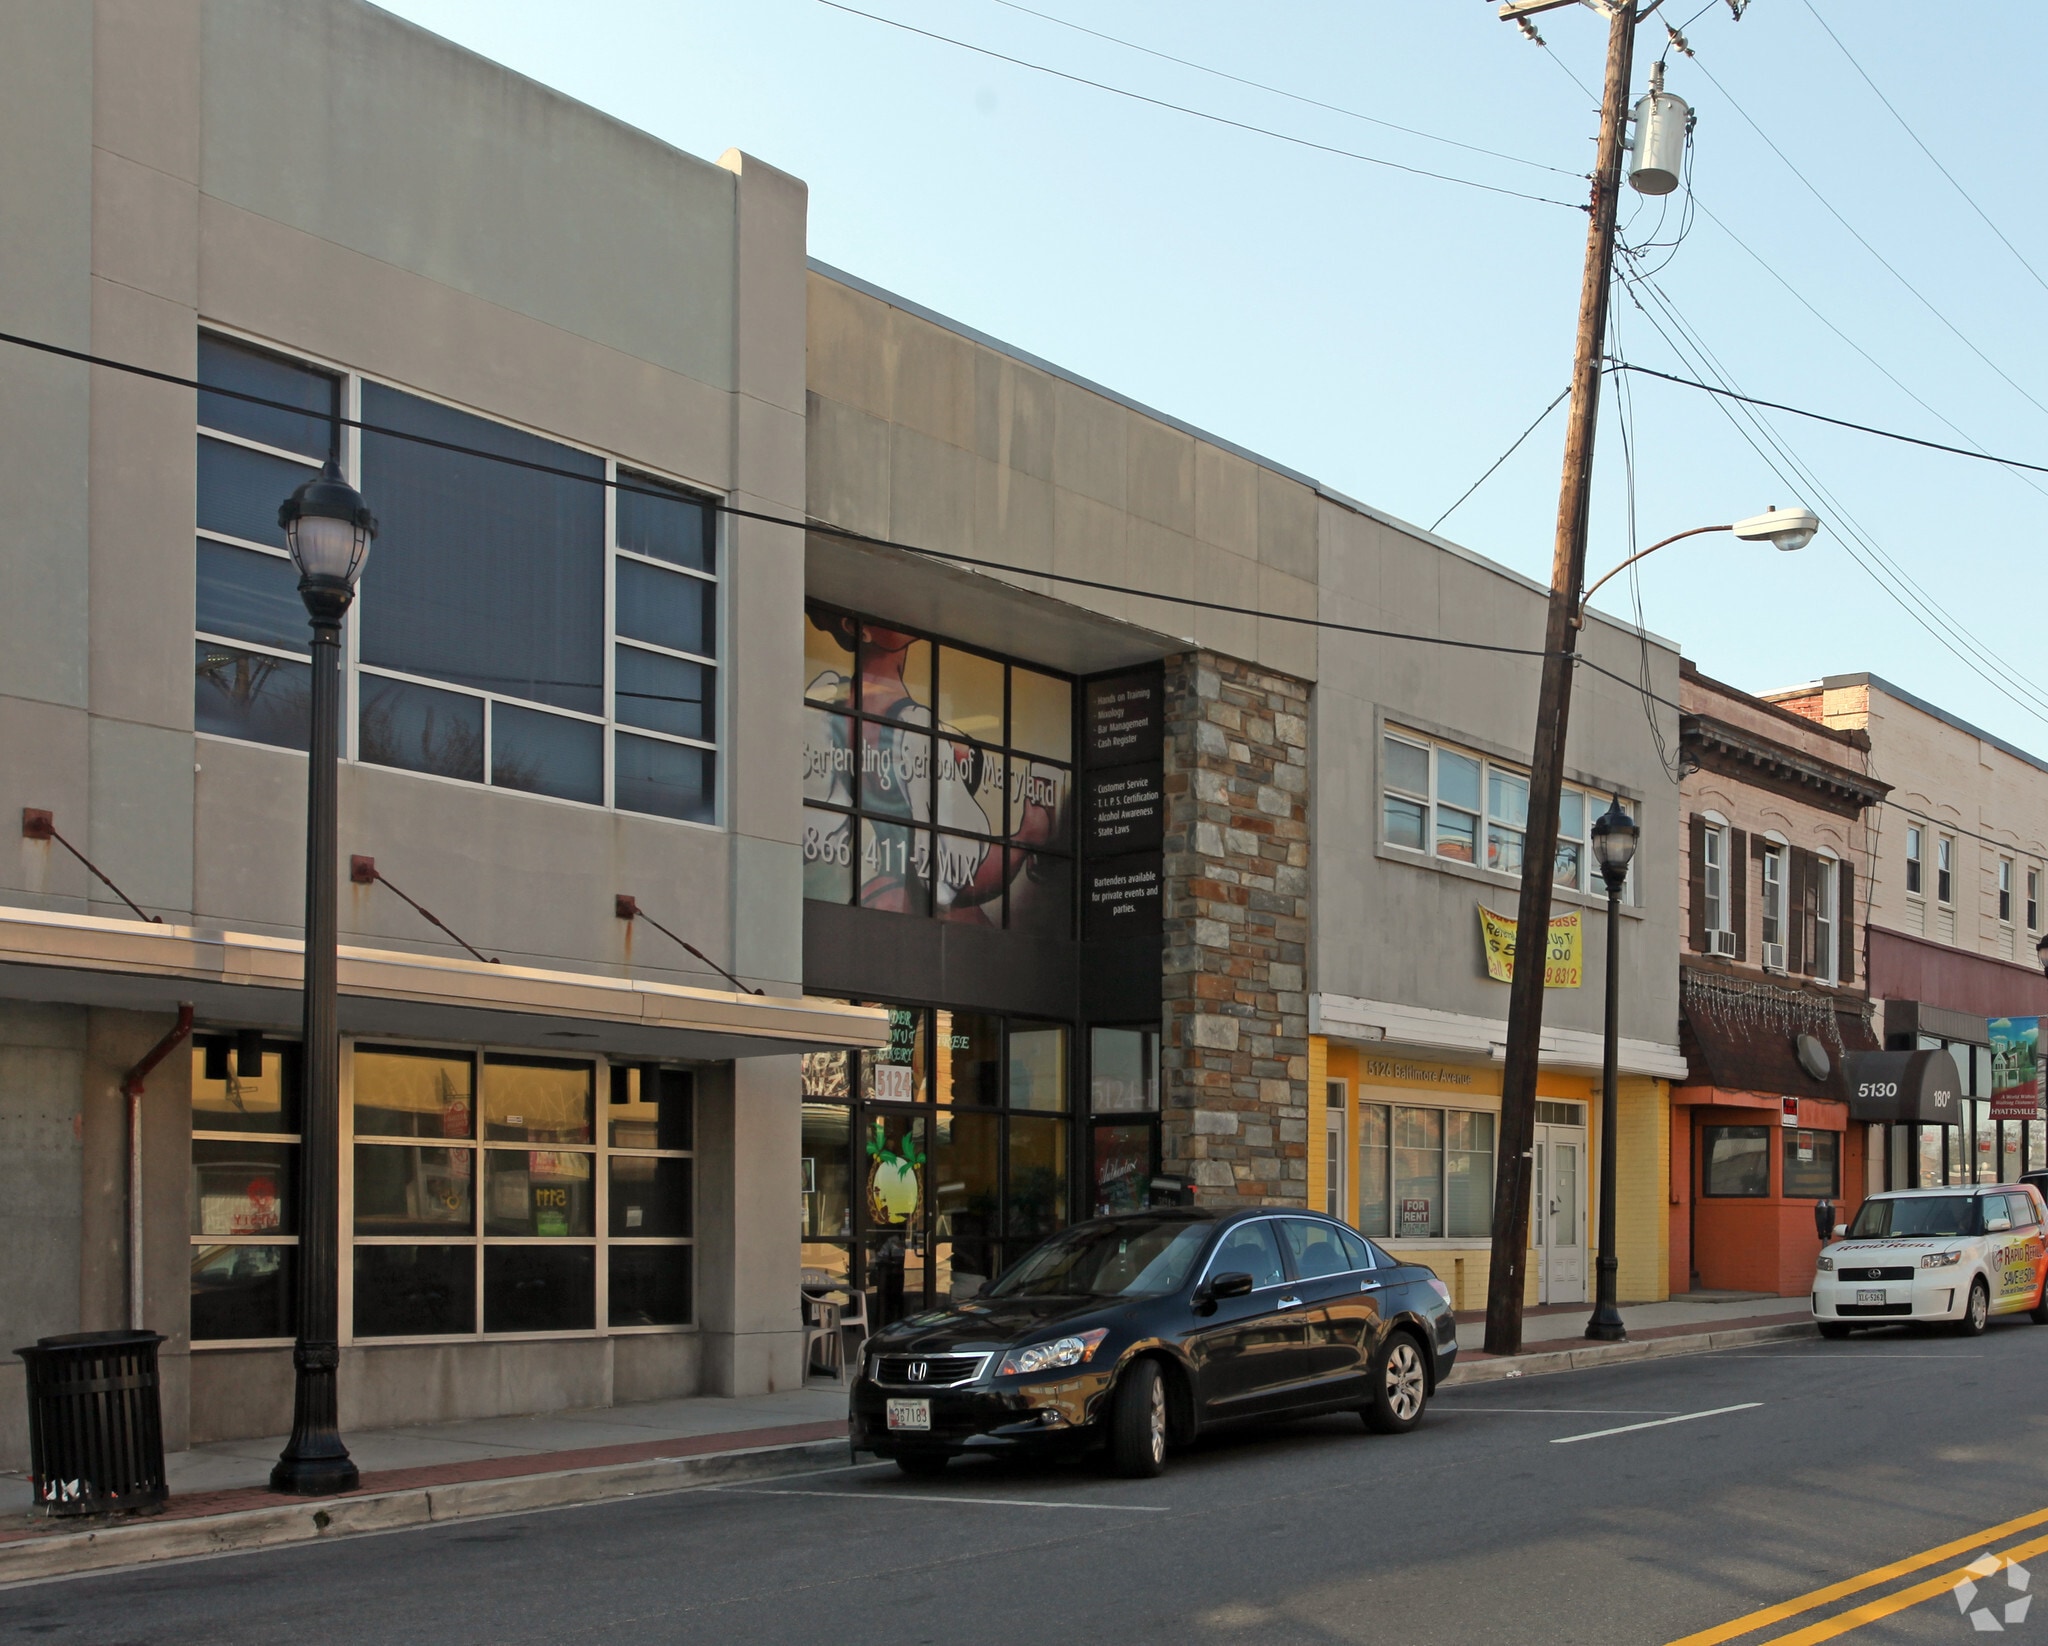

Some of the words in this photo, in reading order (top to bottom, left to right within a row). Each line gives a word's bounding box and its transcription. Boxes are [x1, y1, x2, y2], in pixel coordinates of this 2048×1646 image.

[1098, 694, 1116, 705] Hands
[1117, 693, 1126, 702] on
[1127, 688, 1151, 700] Training
[1098, 708, 1124, 719] Mixology
[1098, 724, 1108, 734] Bar
[1109, 717, 1149, 732] Management
[1098, 737, 1112, 749] Cash
[1113, 734, 1137, 747] Register
[959, 747, 976, 784] of
[982, 755, 1055, 807] Mayland
[1098, 782, 1126, 794] Customer
[1127, 778, 1149, 790] Service
[1123, 791, 1159, 804] Certification
[1098, 810, 1120, 822] Alcohol
[1121, 807, 1154, 819] Awareness
[1098, 827, 1113, 837] State
[1114, 825, 1130, 834] Laws
[1094, 875, 1127, 887] Bartenders
[1128, 871, 1156, 883] available
[1092, 892, 1100, 902] for
[1102, 891, 1123, 903] private
[1124, 888, 1145, 898] events
[1146, 885, 1158, 896] and
[1113, 904, 1136, 916] parties.
[1549, 916, 1578, 928] ease
[1368, 1061, 1392, 1077] 5126
[1394, 1063, 1438, 1083] Baltimore
[1439, 1068, 1472, 1085] Avenue
[877, 1070, 911, 1098] 5124
[1858, 1082, 1897, 1097] 5130
[1407, 1201, 1425, 1211] FOR
[1404, 1212, 1429, 1222] RENT
[1837, 1244, 1885, 1252] RAPID
[2005, 1246, 2024, 1265] RAPID
[2004, 1270, 2018, 1286] SAVE
